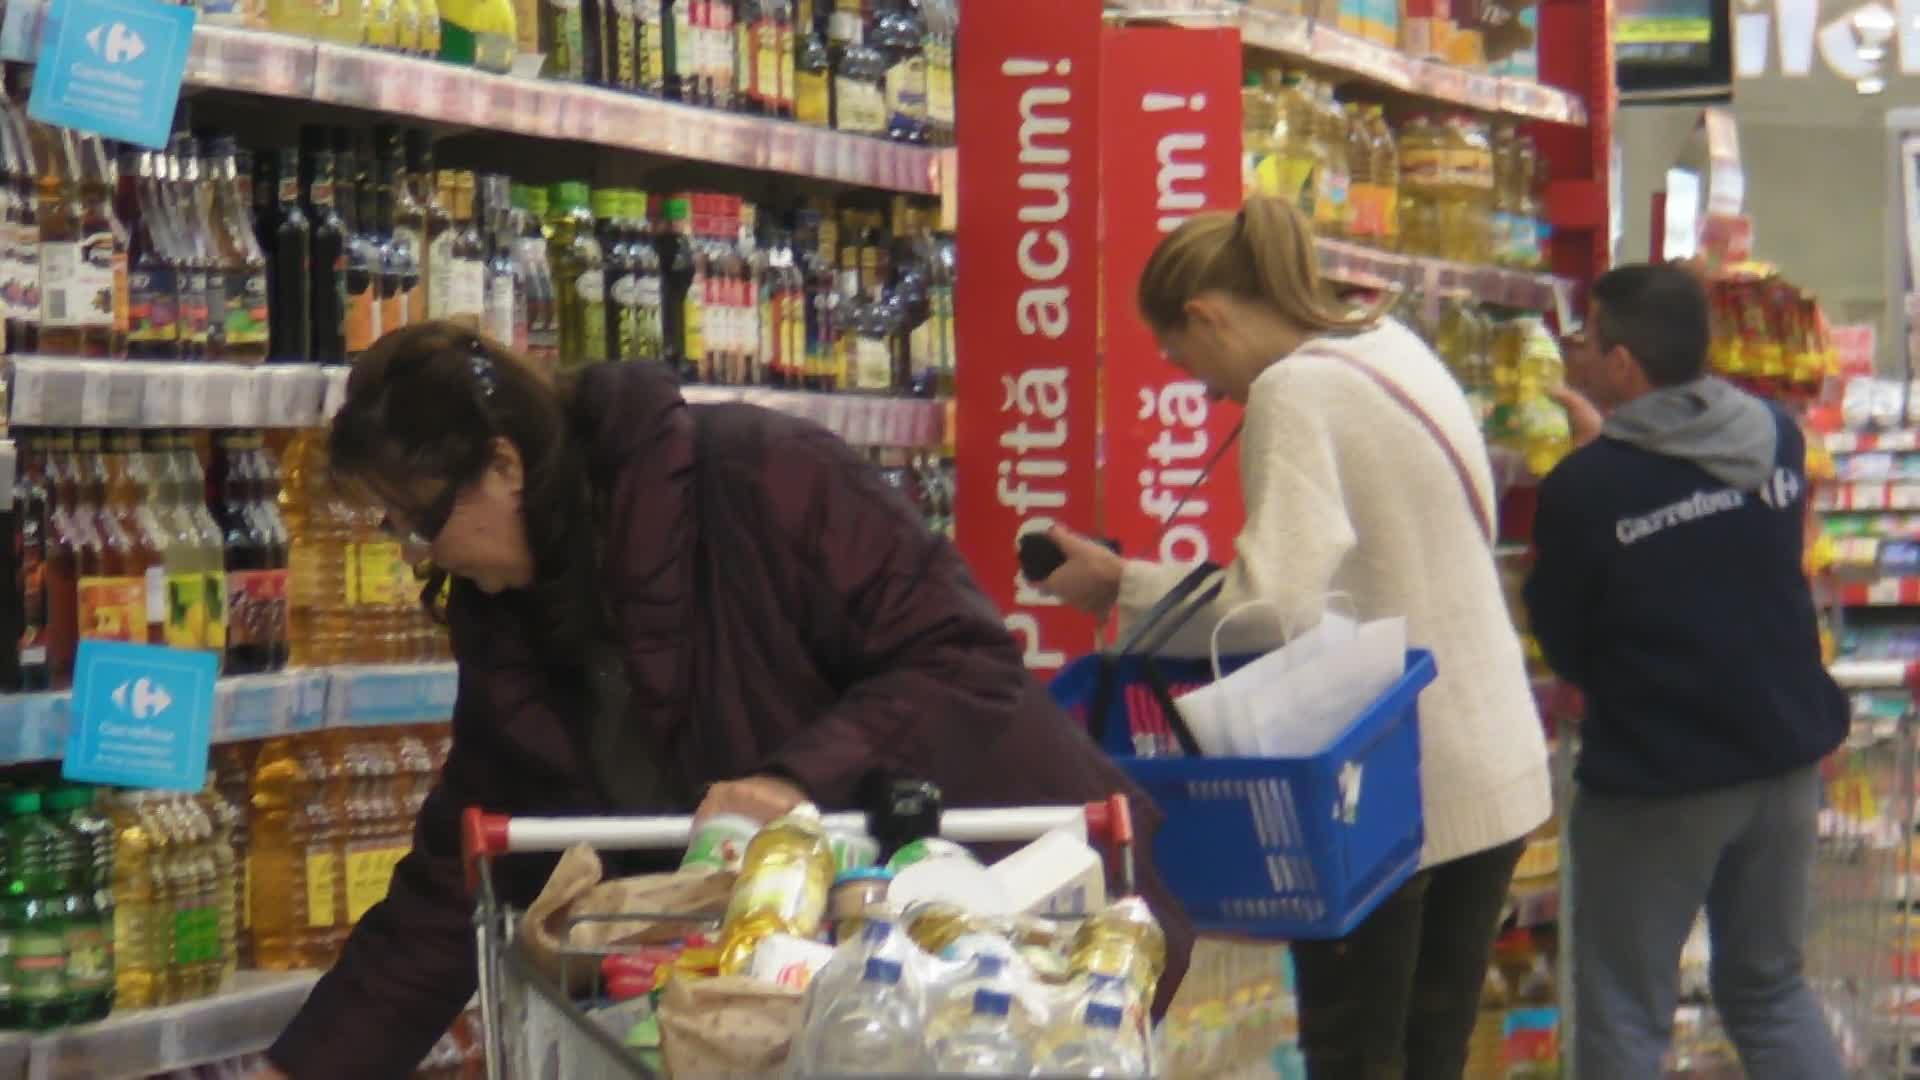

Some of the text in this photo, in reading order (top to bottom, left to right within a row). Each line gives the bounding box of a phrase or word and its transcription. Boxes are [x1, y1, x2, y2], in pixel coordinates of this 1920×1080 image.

[1000, 57, 1073, 339] acum!
[1138, 381, 1209, 567] ofită
[1615, 488, 1745, 545] Carrefour
